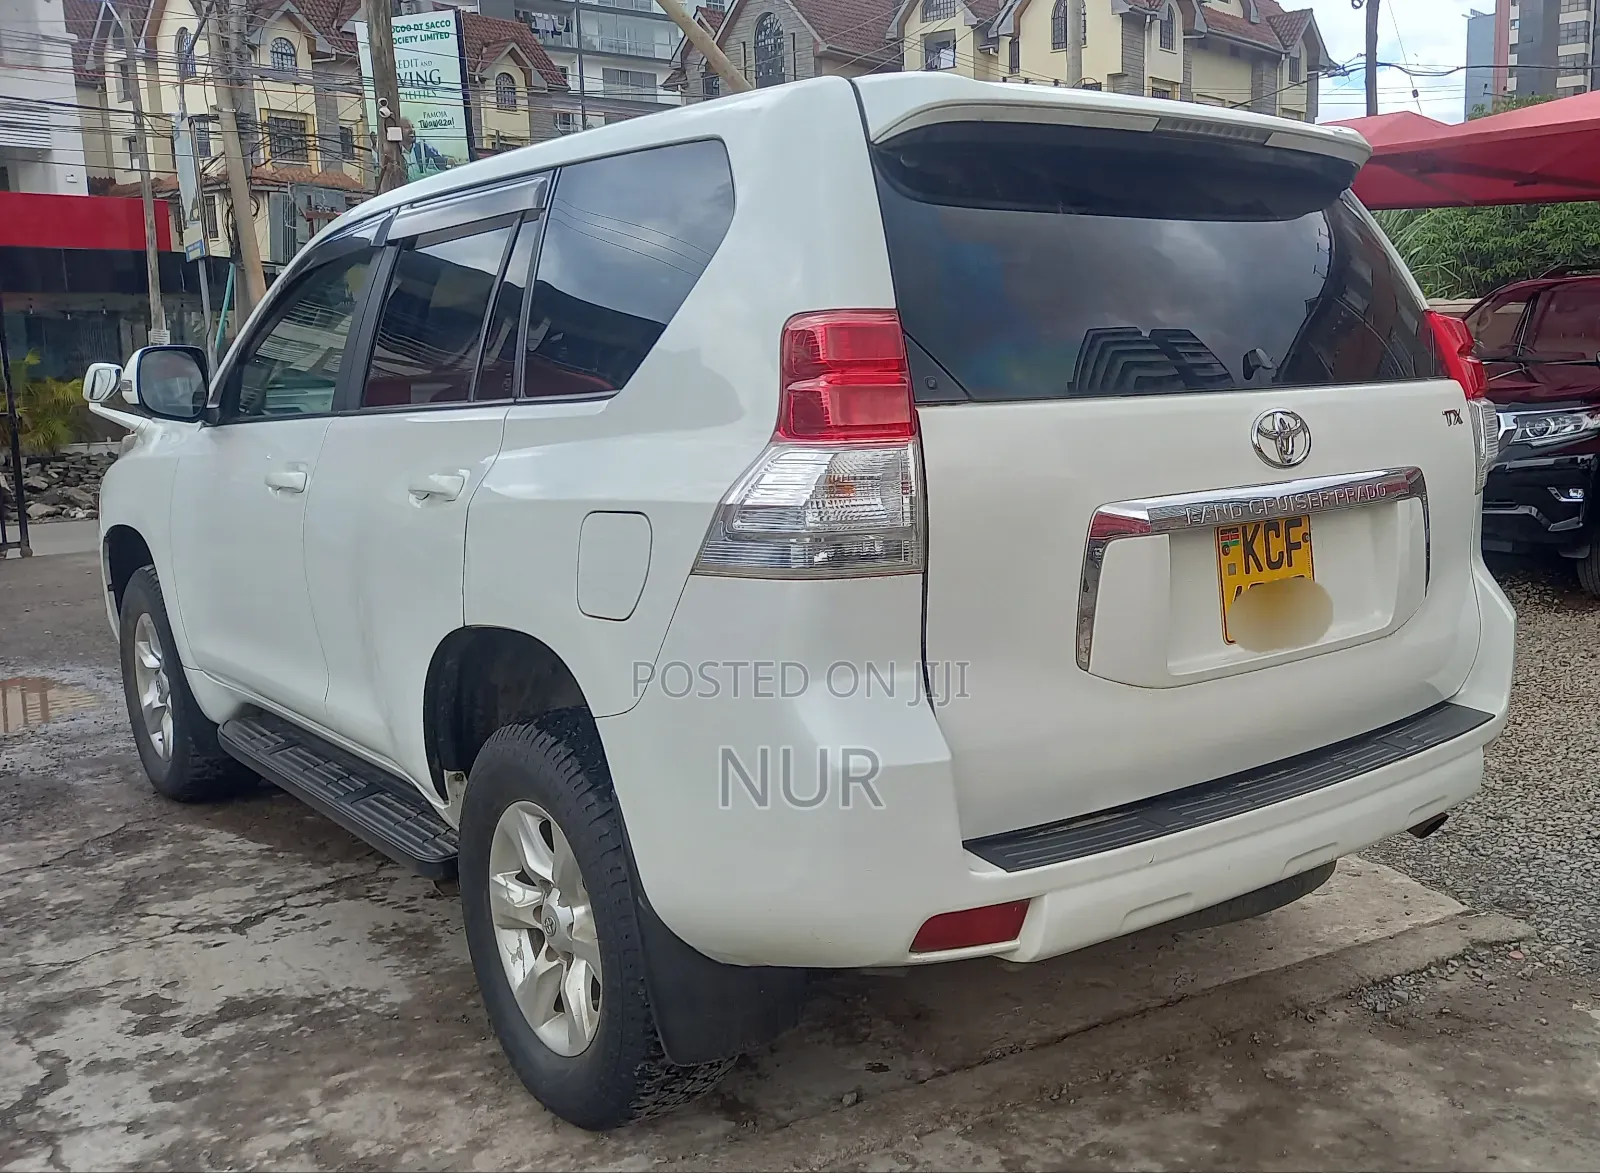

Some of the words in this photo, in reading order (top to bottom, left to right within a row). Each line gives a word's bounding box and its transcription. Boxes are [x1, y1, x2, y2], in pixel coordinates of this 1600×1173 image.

[413, 23, 424, 31] DT
[425, 20, 451, 30] SACCO
[392, 35, 418, 45] OCIETY
[420, 32, 450, 42] LIMITED
[396, 58, 419, 69] EDIT
[397, 69, 441, 87] VING
[1442, 408, 1464, 427] TX
[1185, 502, 1243, 526] LAND
[1249, 491, 1331, 516] CRUISER
[1333, 482, 1387, 506] PRADO
[1241, 517, 1304, 575] KCF
